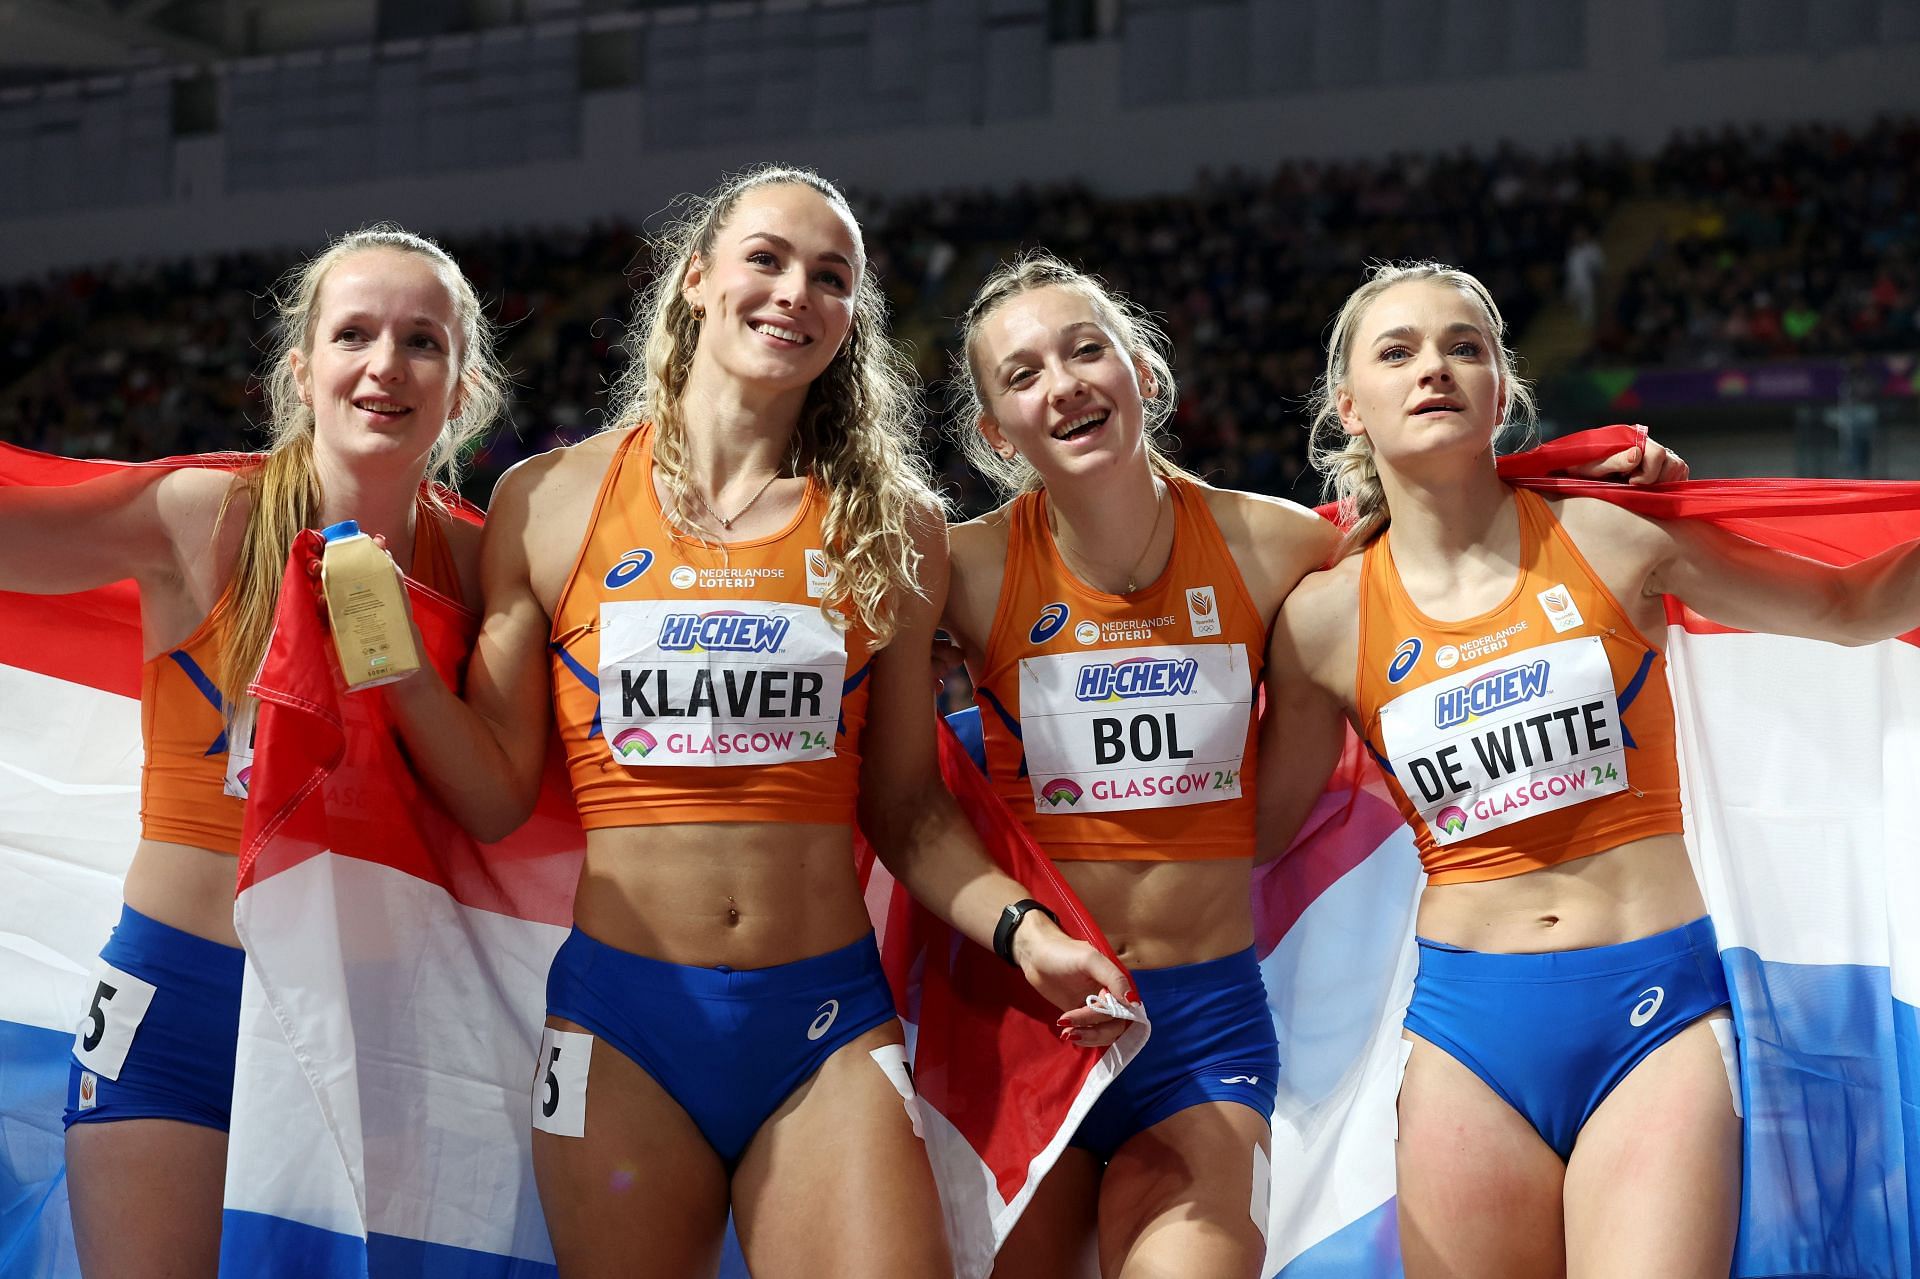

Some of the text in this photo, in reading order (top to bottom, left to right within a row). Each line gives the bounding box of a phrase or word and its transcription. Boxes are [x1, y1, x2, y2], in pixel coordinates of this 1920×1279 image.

[699, 568, 785, 578] NEDERLANDSE
[699, 578, 755, 588] LOTERIJ
[657, 613, 790, 654] HI-CHEW
[1102, 615, 1176, 632] NEDERLANDSE
[1102, 629, 1152, 642] LOTERIJ
[1459, 620, 1529, 653] NEDERLANDSE
[1461, 640, 1509, 662] LOTERIJ
[620, 669, 824, 718] KLAVER
[1075, 659, 1199, 702] HI-CHEW
[1435, 660, 1550, 730] HI-CHEW
[667, 731, 827, 755] GLASGOW 24
[1092, 712, 1194, 765] BOL
[1408, 700, 1611, 804] DE WITTE
[1091, 770, 1234, 800] GLASGOW 24
[1474, 762, 1618, 821] GLASGOW 24
[83, 980, 118, 1052] 5
[543, 1046, 561, 1118] 5
